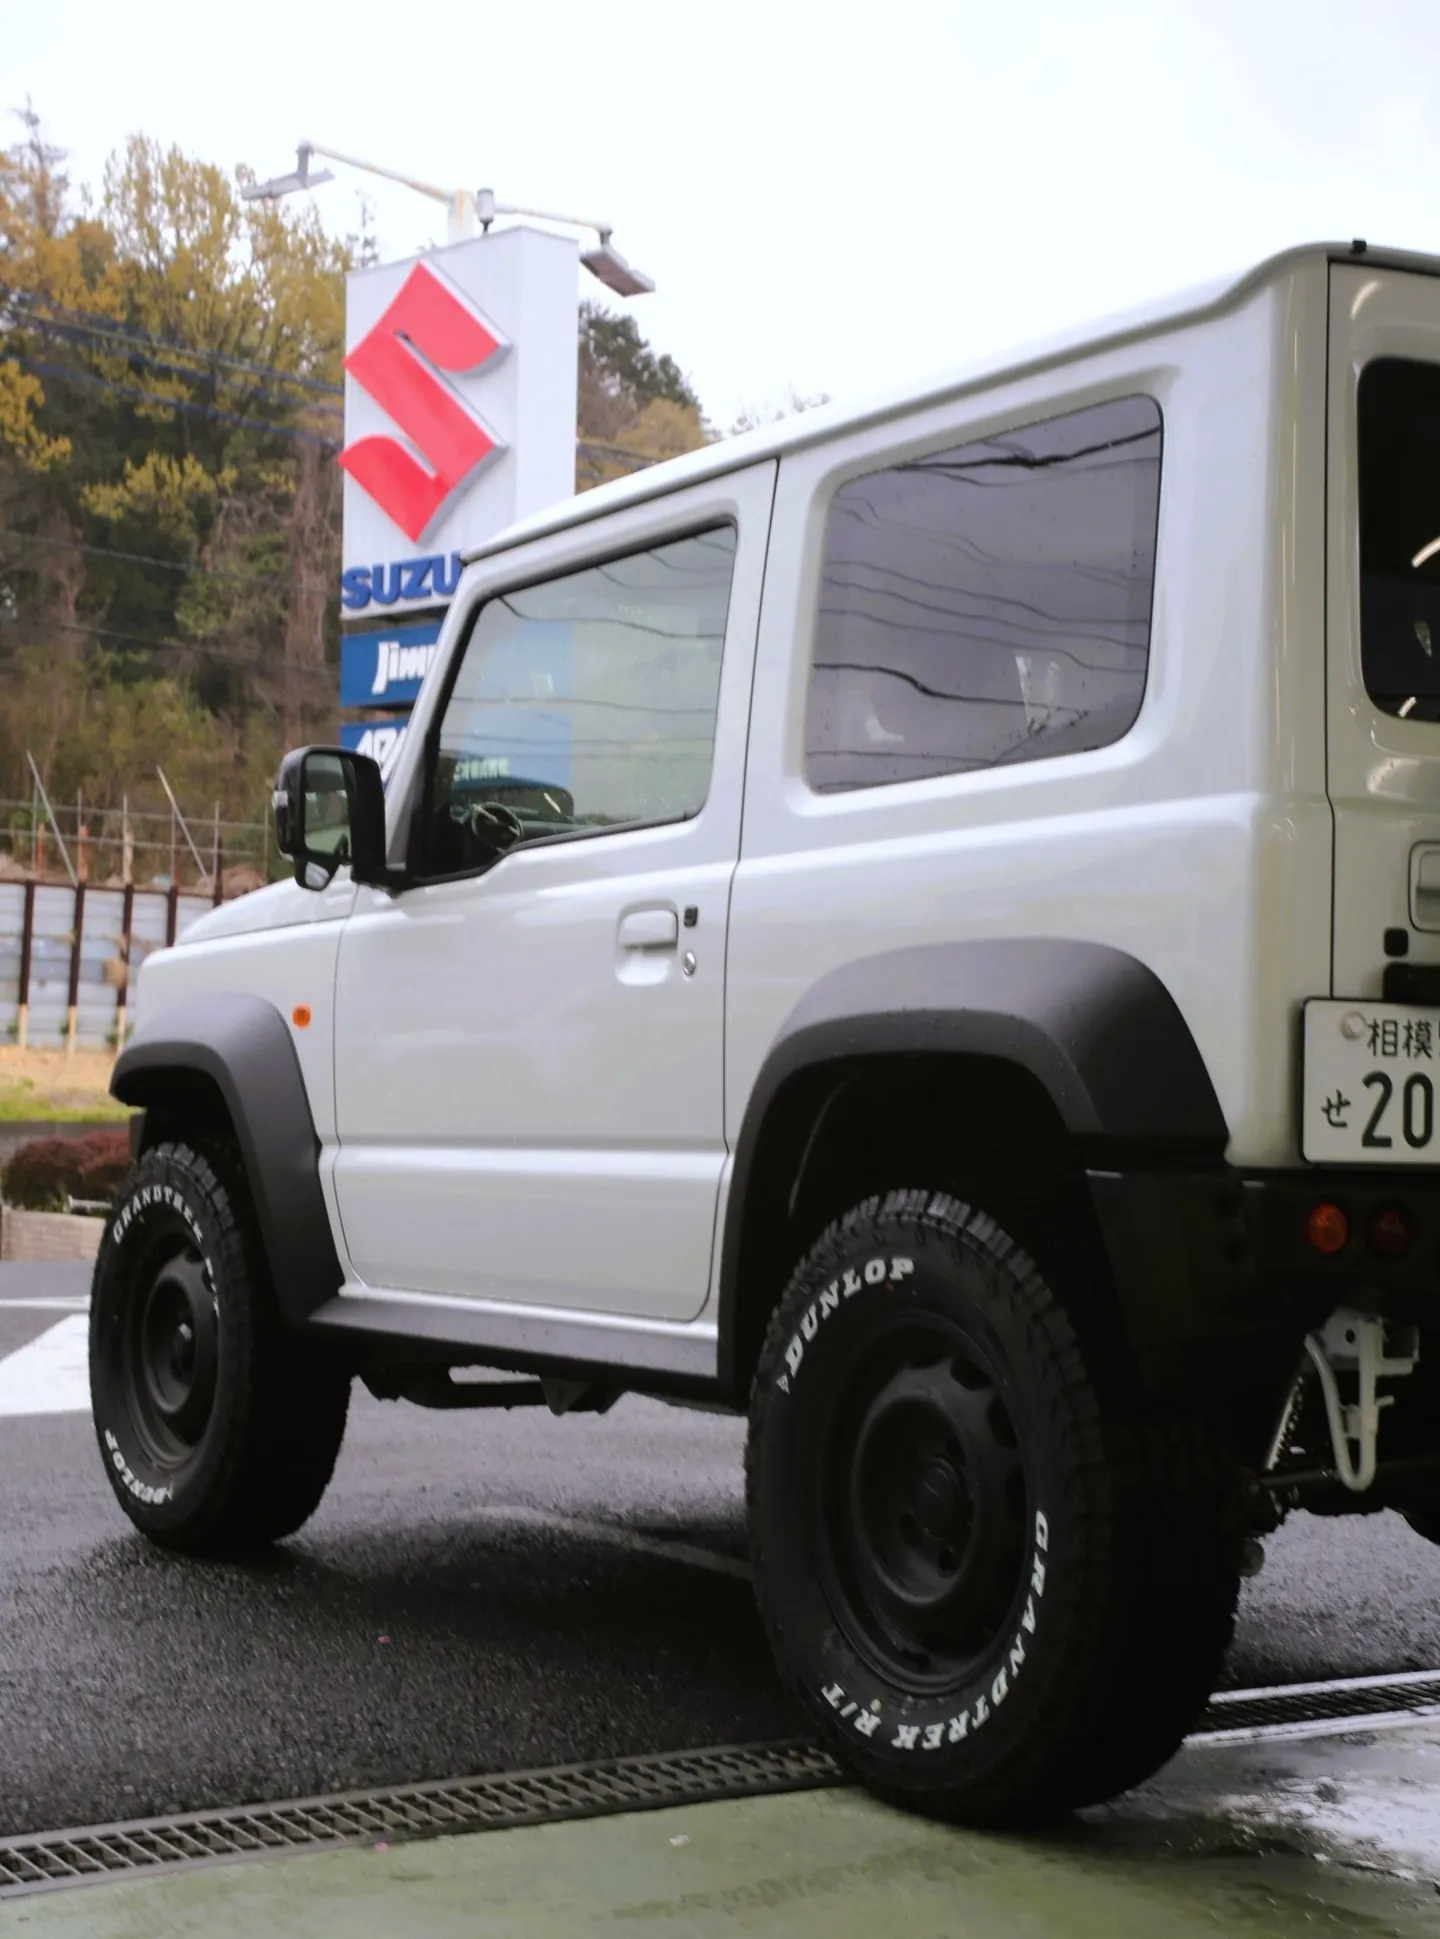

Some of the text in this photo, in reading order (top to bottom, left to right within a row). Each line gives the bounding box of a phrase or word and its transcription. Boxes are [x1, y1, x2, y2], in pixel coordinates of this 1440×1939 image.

[1366, 1018, 1433, 1060] 相模
[1320, 1070, 1434, 1149] せ 20
[784, 1257, 915, 1379] DUNLOP
[820, 1510, 1049, 1750] GRANDTREK R/T
